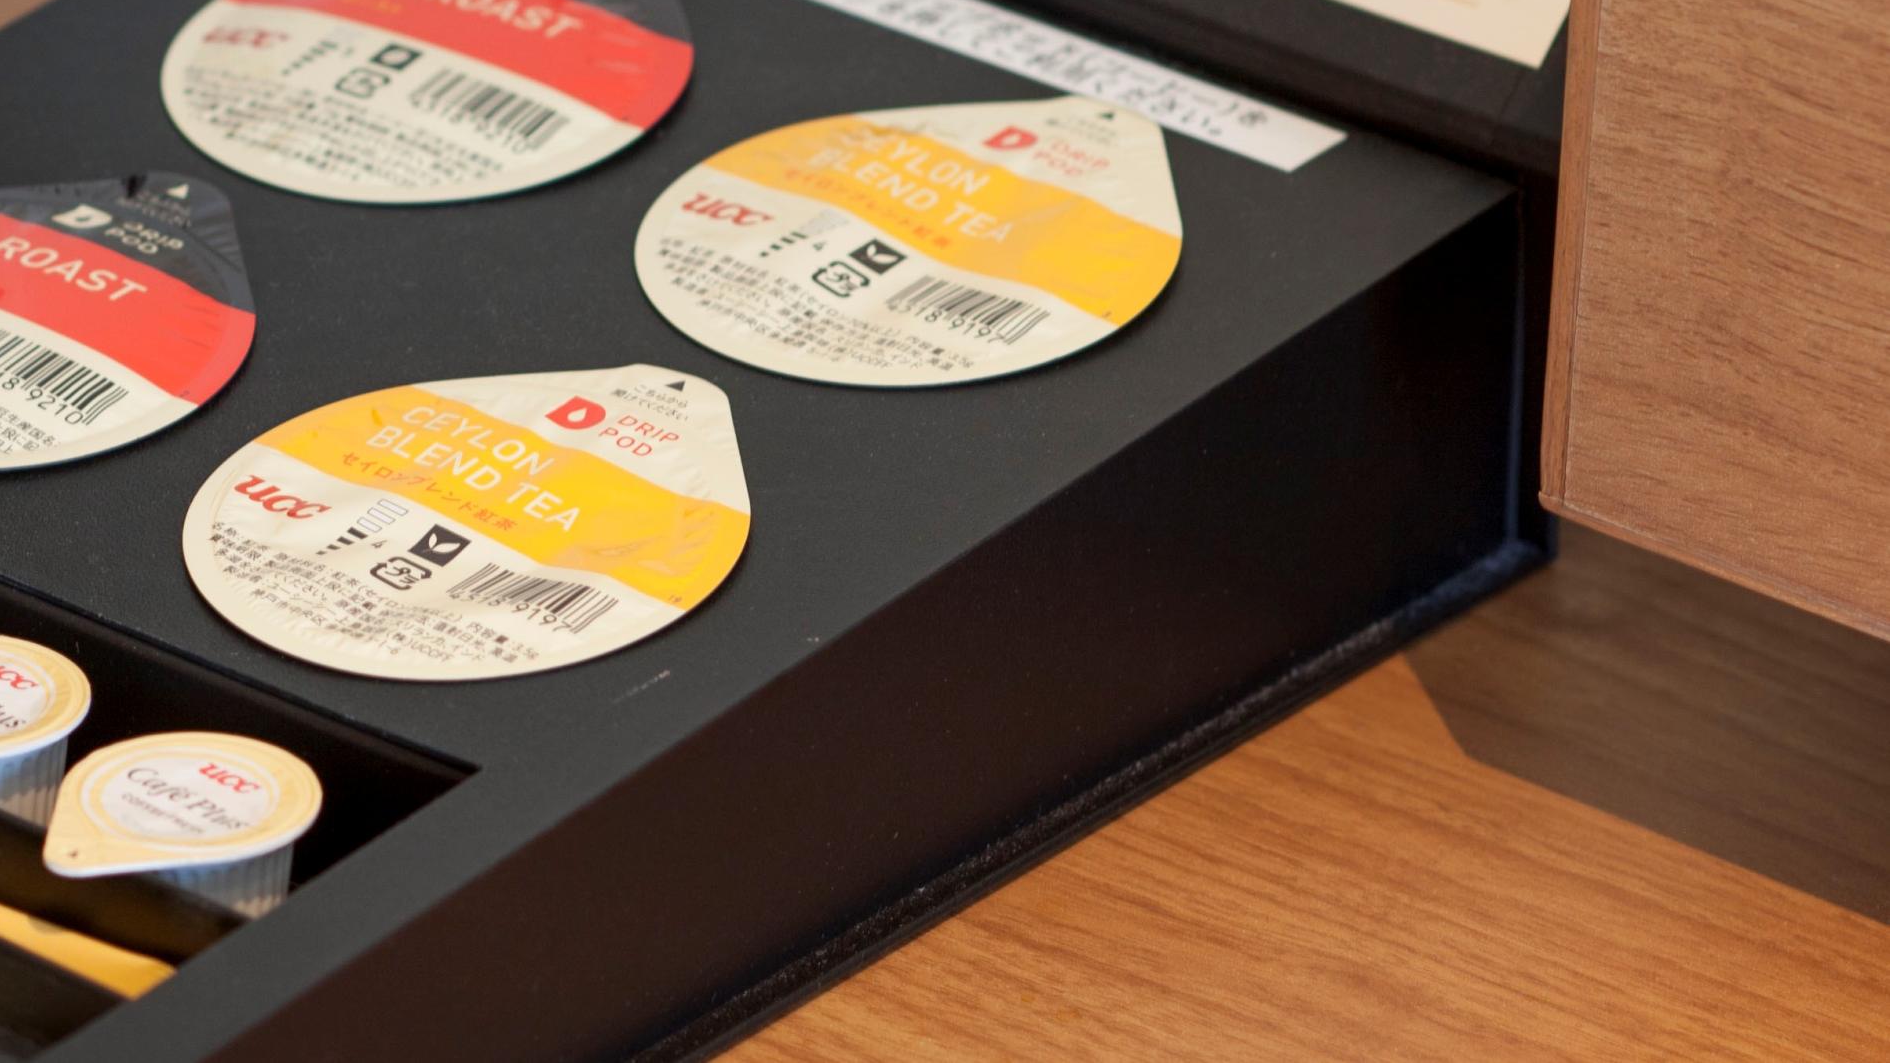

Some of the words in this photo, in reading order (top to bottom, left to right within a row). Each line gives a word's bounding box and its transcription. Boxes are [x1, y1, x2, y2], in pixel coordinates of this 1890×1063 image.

[808, 148, 939, 210] BLEND
[942, 197, 1018, 245] TEA
[105, 228, 158, 254] POD
[123, 222, 184, 250] DRIP
[402, 406, 555, 477] CEYLON
[598, 427, 653, 457] POD
[617, 415, 680, 442] DRIP
[233, 474, 332, 521] ucc
[341, 452, 519, 532] セイロンブレンド紅茶
[366, 425, 501, 492] BLEND
[504, 472, 587, 533] TEA
[197, 762, 263, 796] ucc
